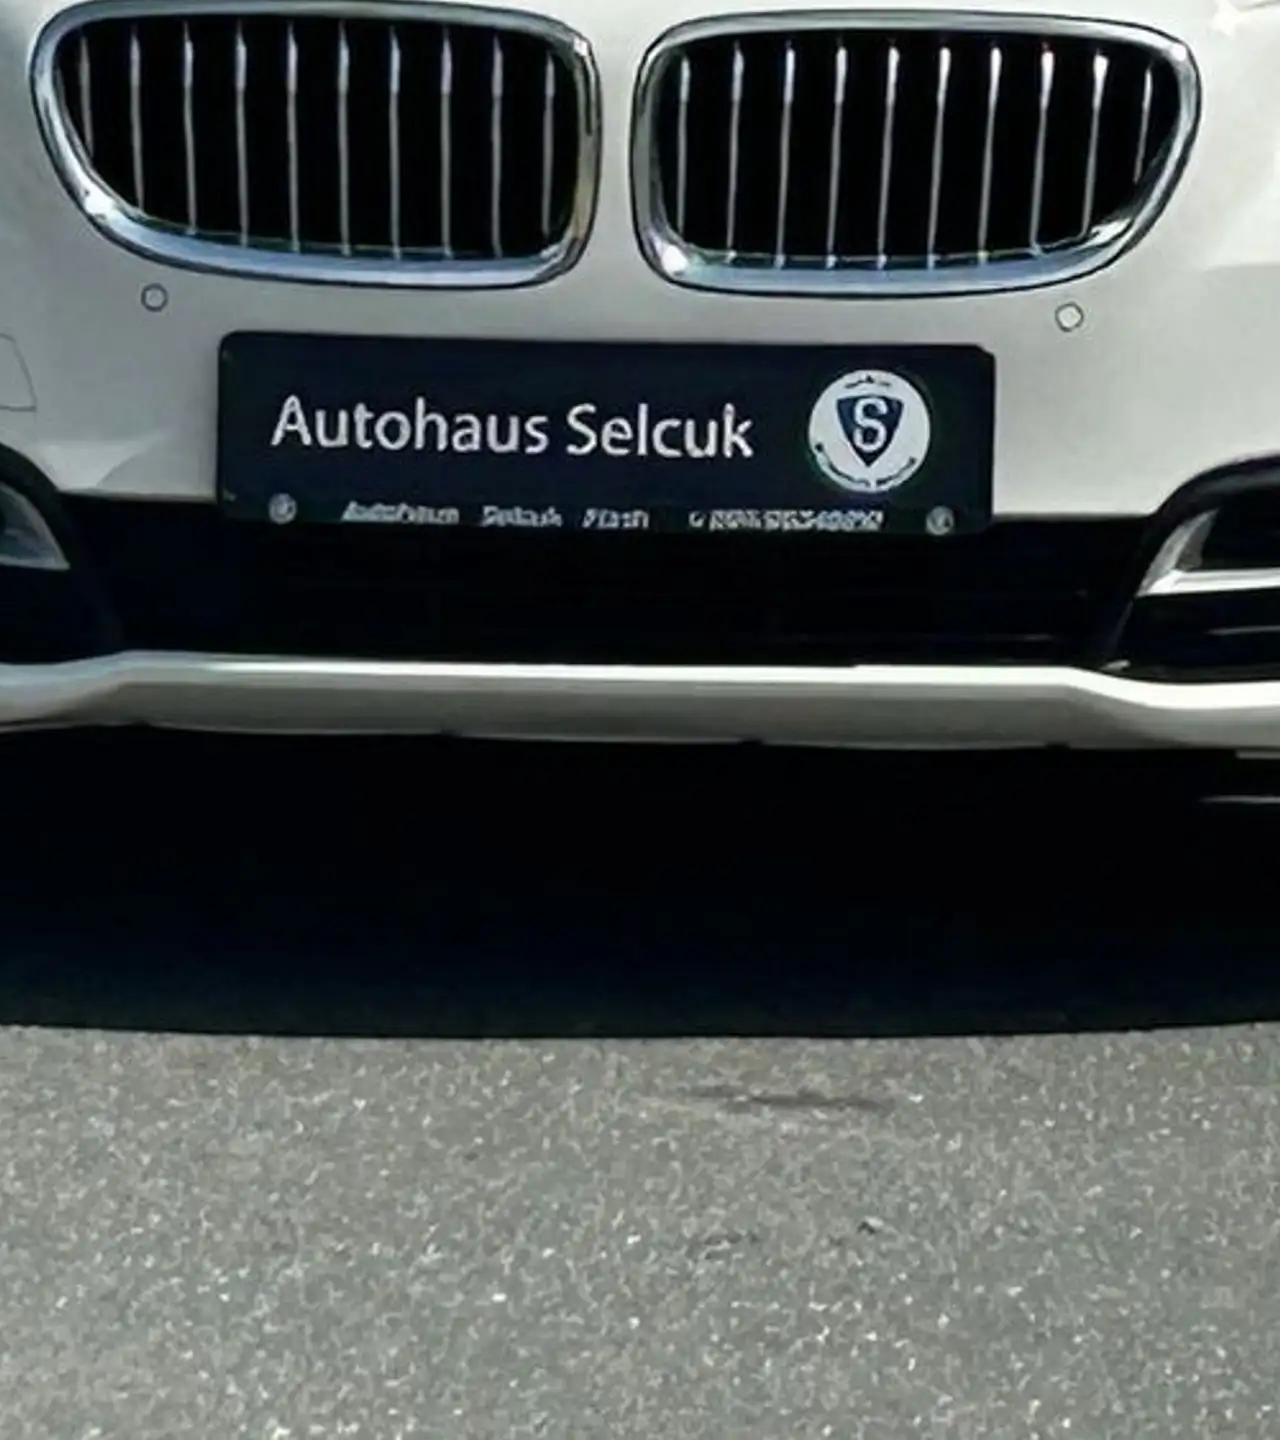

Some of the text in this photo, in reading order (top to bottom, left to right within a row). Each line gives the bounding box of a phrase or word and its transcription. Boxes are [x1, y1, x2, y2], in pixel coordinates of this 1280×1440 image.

[270, 393, 754, 458] Autohaus Selcuk
[852, 396, 889, 453] S
